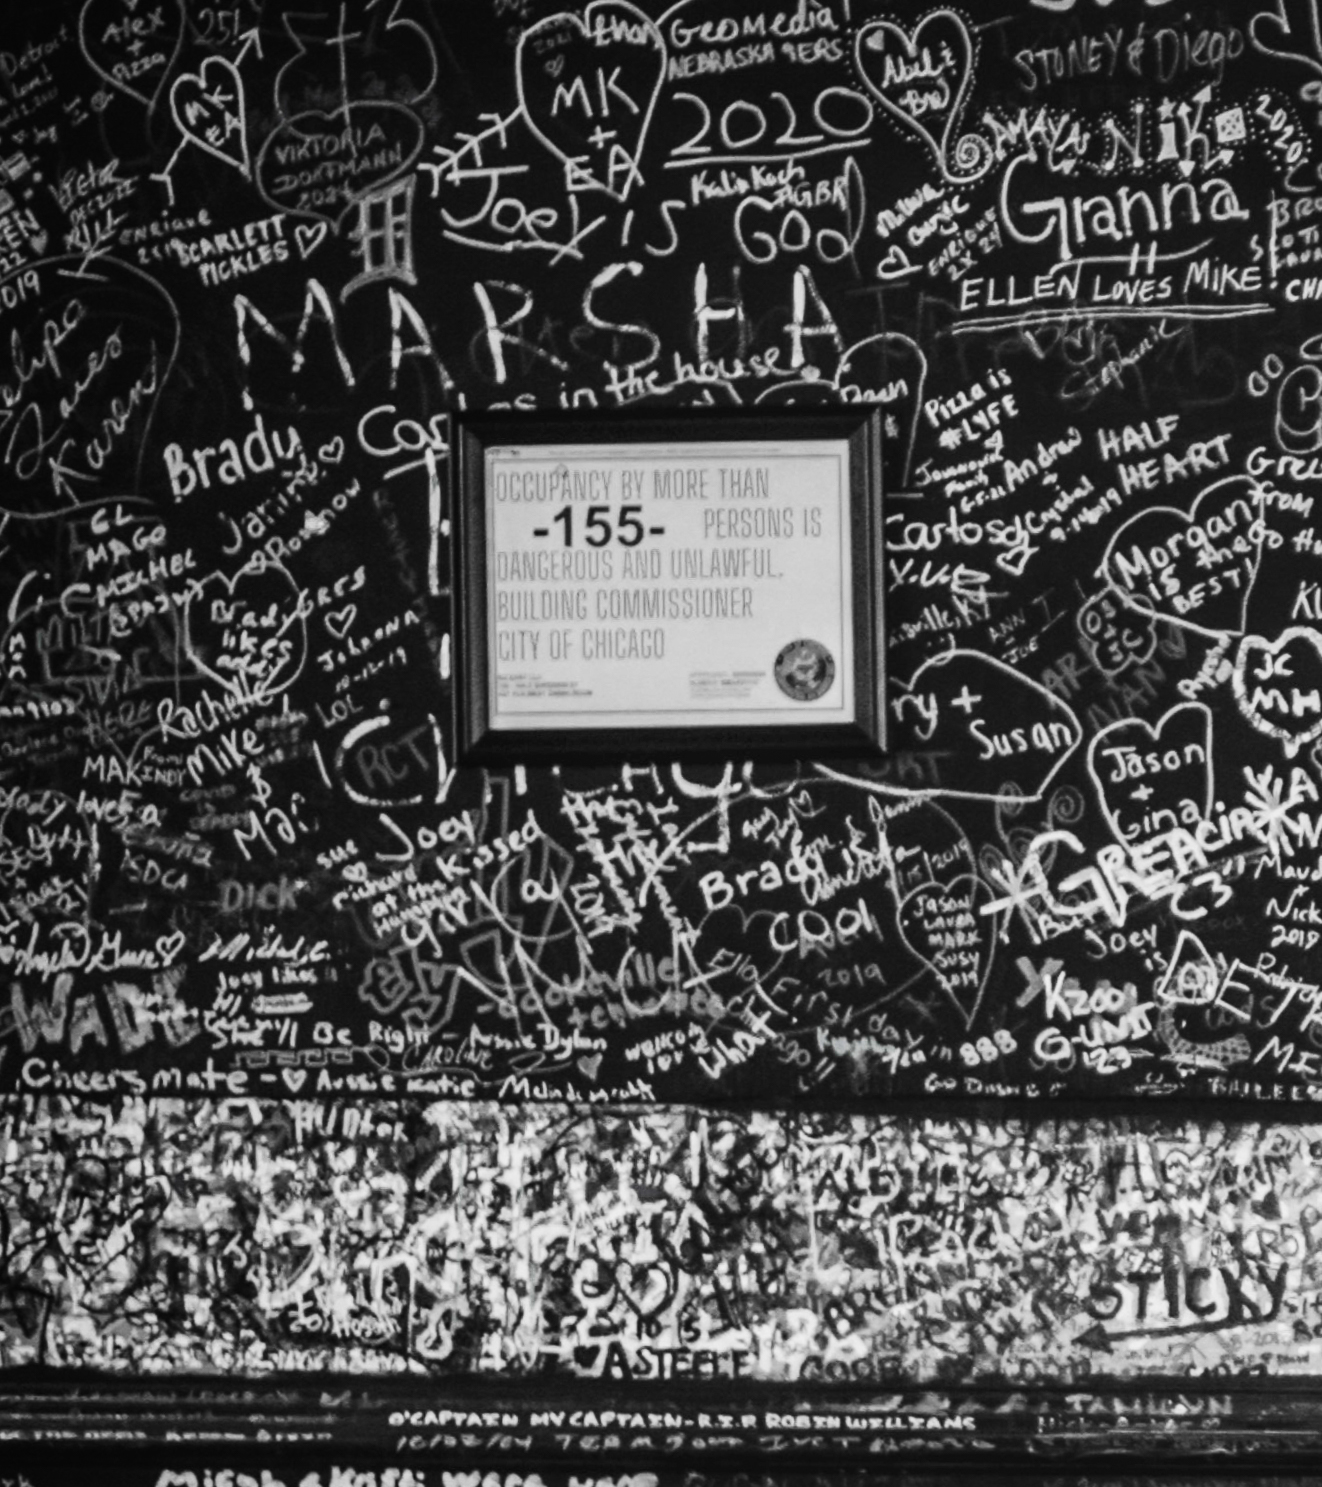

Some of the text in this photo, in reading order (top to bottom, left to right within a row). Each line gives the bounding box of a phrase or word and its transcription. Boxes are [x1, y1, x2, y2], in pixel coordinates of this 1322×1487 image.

[671, 87, 874, 157] 2020
[273, 145, 403, 194] DORTMANN
[180, 214, 287, 268] SCARLETT
[960, 262, 1081, 311] ELLEN
[234, 262, 846, 411] MARSHA
[925, 368, 1012, 427] Pizza is
[1098, 415, 1180, 460] HALF
[495, 468, 769, 502] OCCUPANCY BY MORE THAN
[1117, 434, 1232, 494] HEART
[532, 505, 665, 548] -155-
[704, 507, 822, 539] PERSONS IS
[1114, 498, 1253, 590] Morgan
[496, 549, 784, 581] DANGEROUS AND UNLAWFUL.
[497, 587, 754, 620] BUILDING COMMISSIONER
[498, 629, 665, 660] CITY OF CHICAGO
[970, 718, 1073, 759] Susan
[1102, 744, 1205, 783] Jason
[21, 1056, 147, 1090] Cheers
[153, 1056, 250, 1092] mate
[1091, 1258, 1287, 1322] STICKY
[764, 1412, 842, 1430] ROBIN
